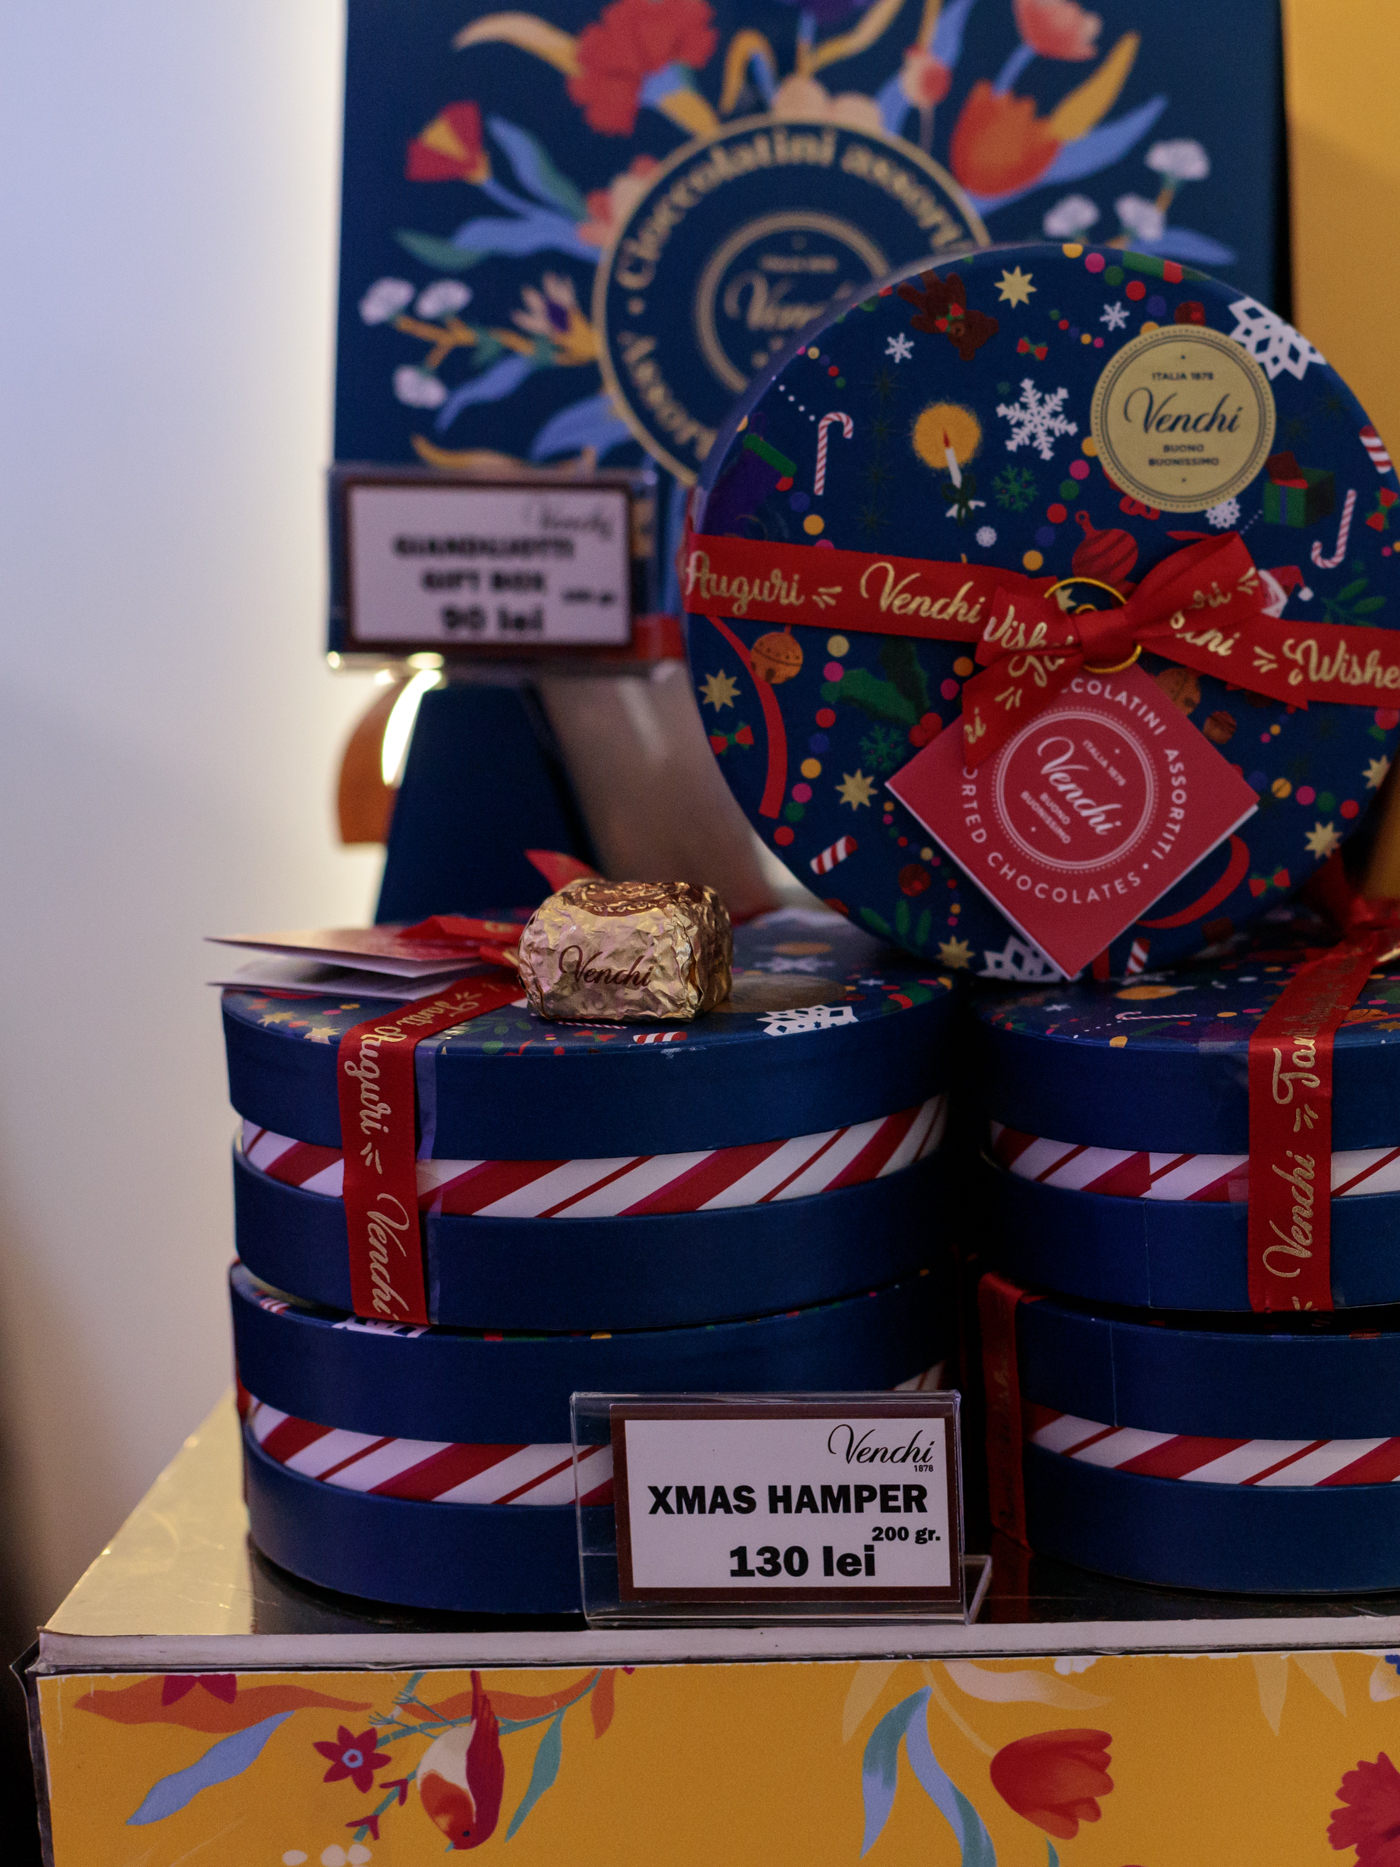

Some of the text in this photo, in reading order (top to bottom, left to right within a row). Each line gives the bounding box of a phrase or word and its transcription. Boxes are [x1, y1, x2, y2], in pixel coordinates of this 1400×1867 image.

[1152, 372, 1214, 381] ITALIA 1878
[1123, 387, 1243, 434] Venchi
[1148, 458, 1219, 466] BUONISSIMO
[1163, 444, 1204, 453] BUONO
[685, 550, 986, 624] Auguri Venchi
[1082, 739, 1110, 769] ITALIA
[1036, 736, 1122, 836] Venchi
[1152, 748, 1188, 860] ASSORTITI
[1020, 790, 1071, 845] BUONISSIMO
[1039, 792, 1071, 826] BUONO
[987, 851, 1142, 904] CHOCOLATES
[558, 944, 655, 990] Venchi
[344, 1026, 408, 1136] Auguri
[1262, 1150, 1317, 1278] Venchi
[366, 1192, 410, 1317] Venchi
[827, 1424, 935, 1464] Venchi
[914, 1464, 934, 1473] 1878
[648, 1484, 928, 1514] XMAS HAMPER
[872, 1526, 941, 1545] 200 gr.
[729, 1544, 876, 1577] 130 lei
